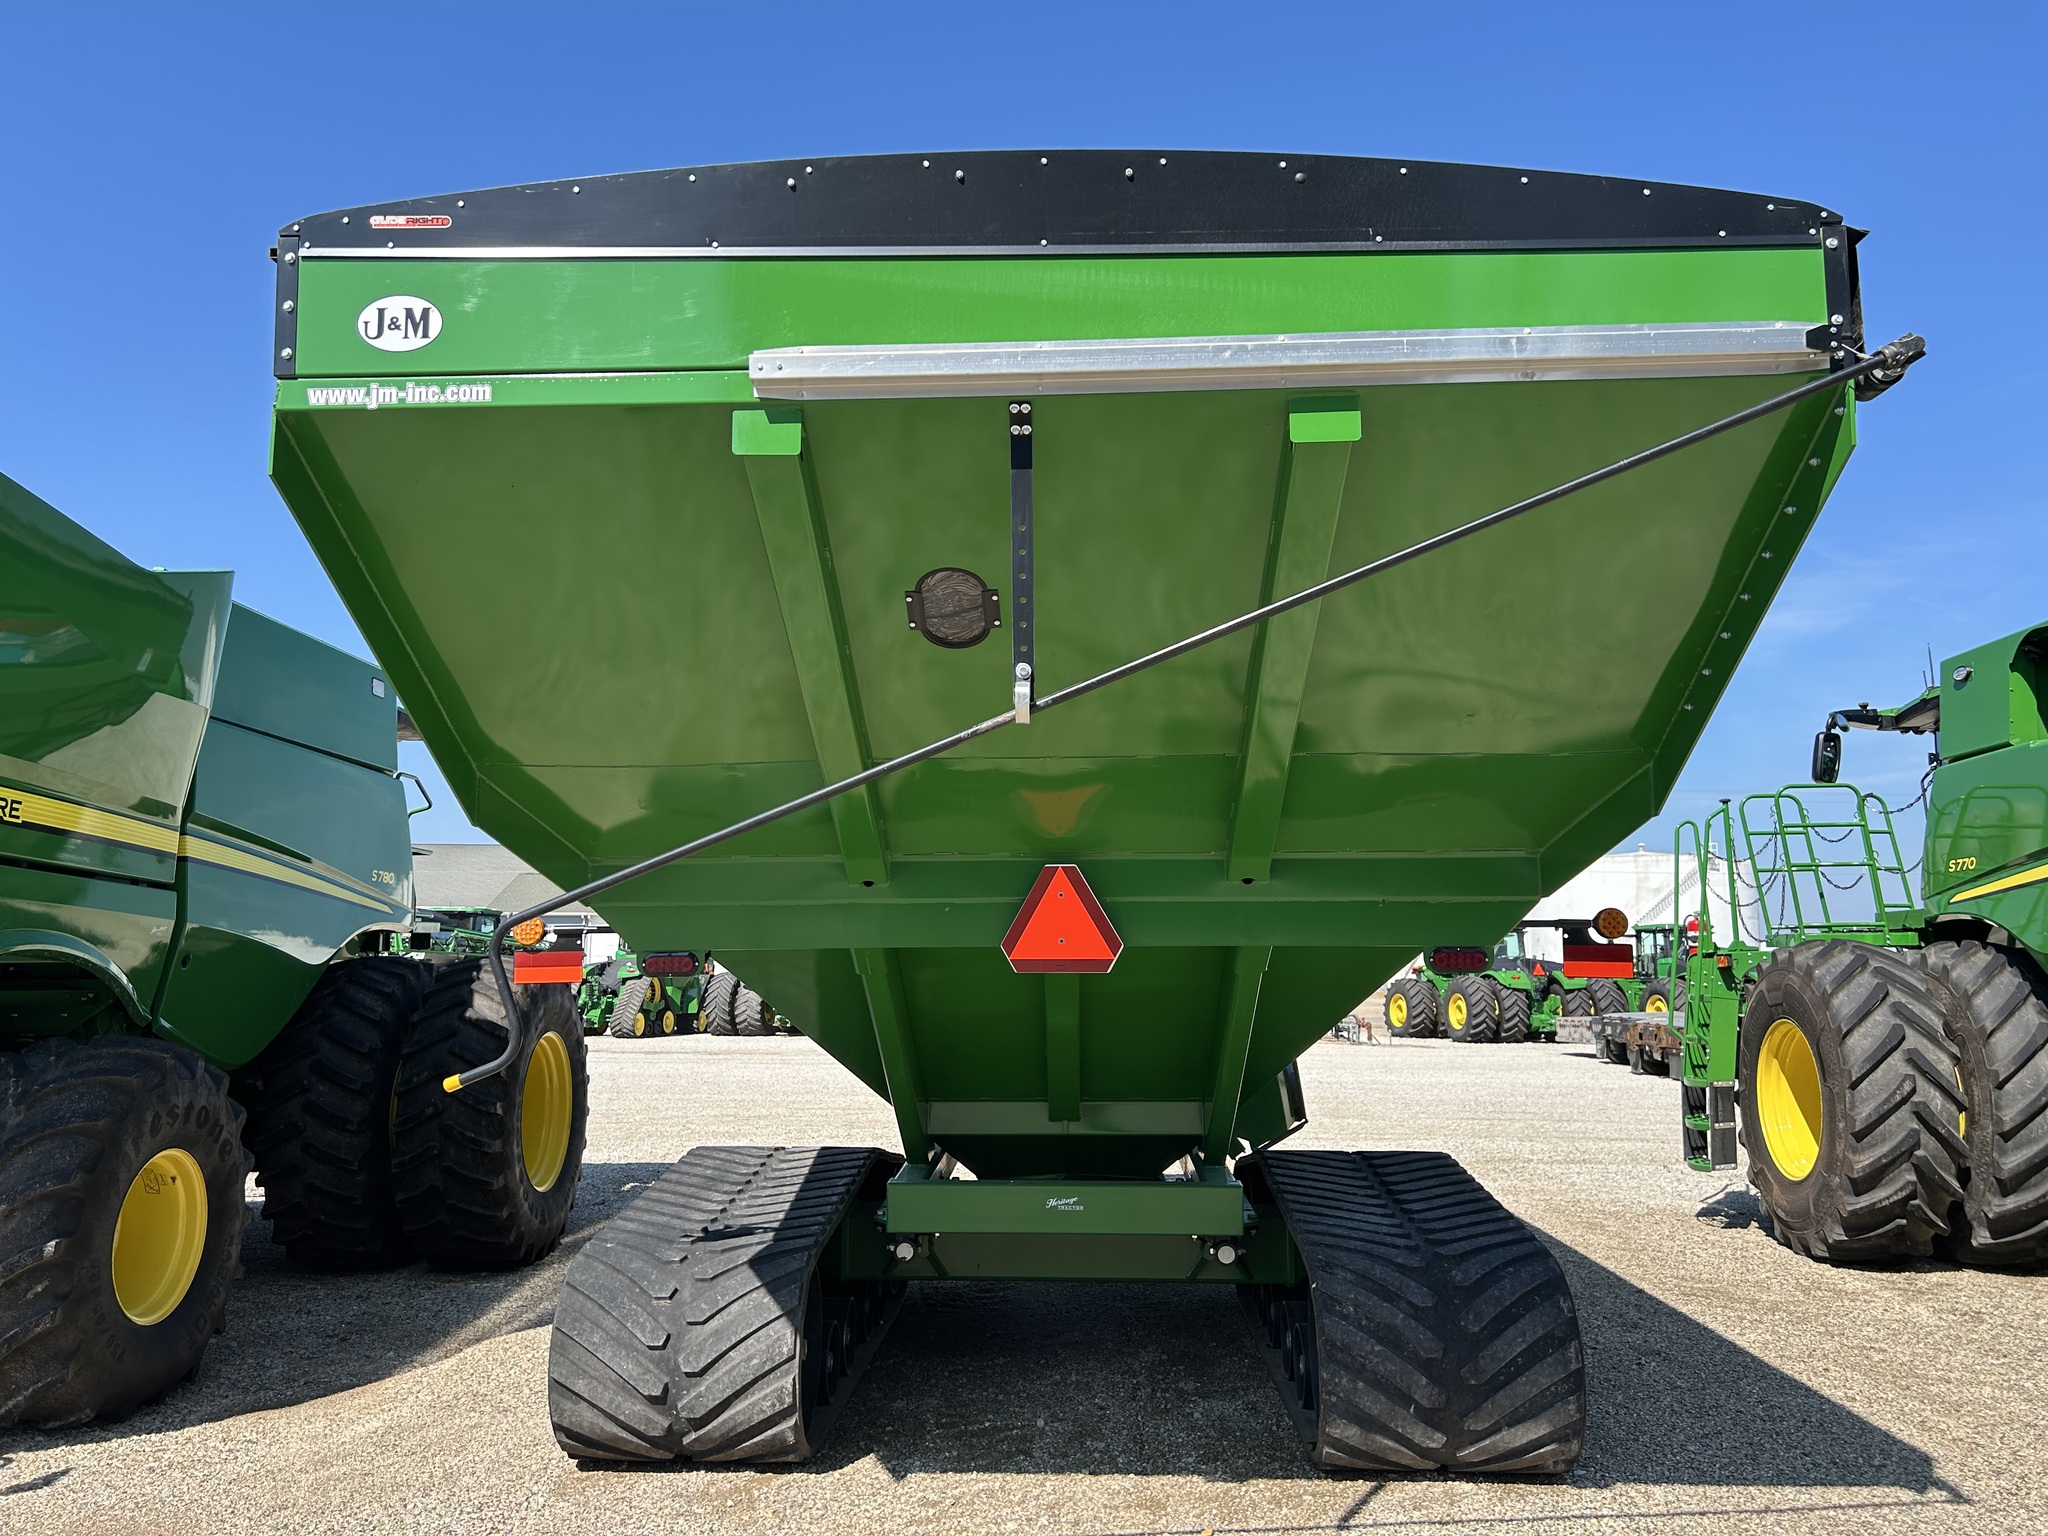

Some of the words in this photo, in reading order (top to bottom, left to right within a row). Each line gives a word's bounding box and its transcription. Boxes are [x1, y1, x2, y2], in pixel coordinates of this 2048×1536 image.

[363, 307, 431, 340] J&M
[308, 383, 492, 409] www.jm-inc.com
[1948, 857, 1976, 872] S770
[371, 869, 395, 885] S780
[1046, 1197, 1078, 1209] Heritage
